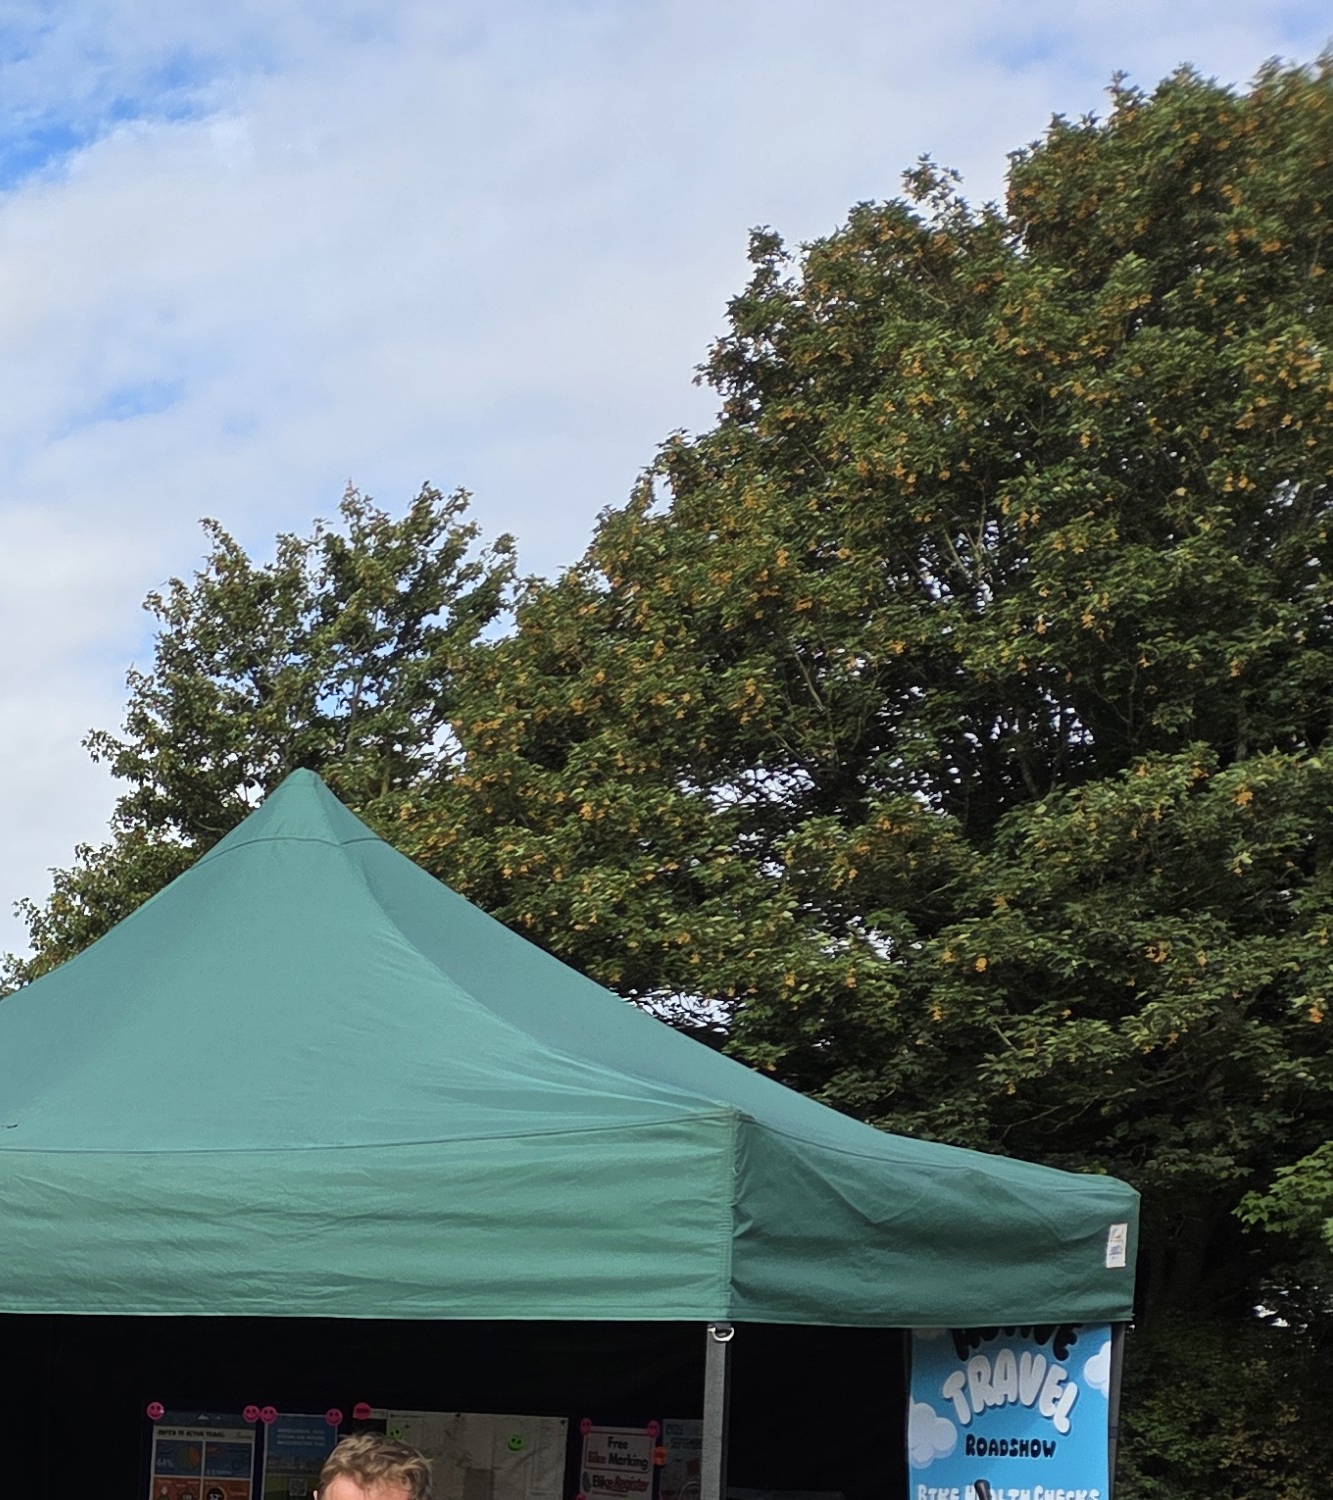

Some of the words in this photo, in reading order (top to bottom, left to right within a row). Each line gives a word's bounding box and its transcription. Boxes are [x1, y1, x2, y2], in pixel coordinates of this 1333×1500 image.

[943, 1348, 1078, 1434] TRAVEL
[608, 1437, 628, 1449] Free
[965, 1433, 1057, 1458] ROADSHOW
